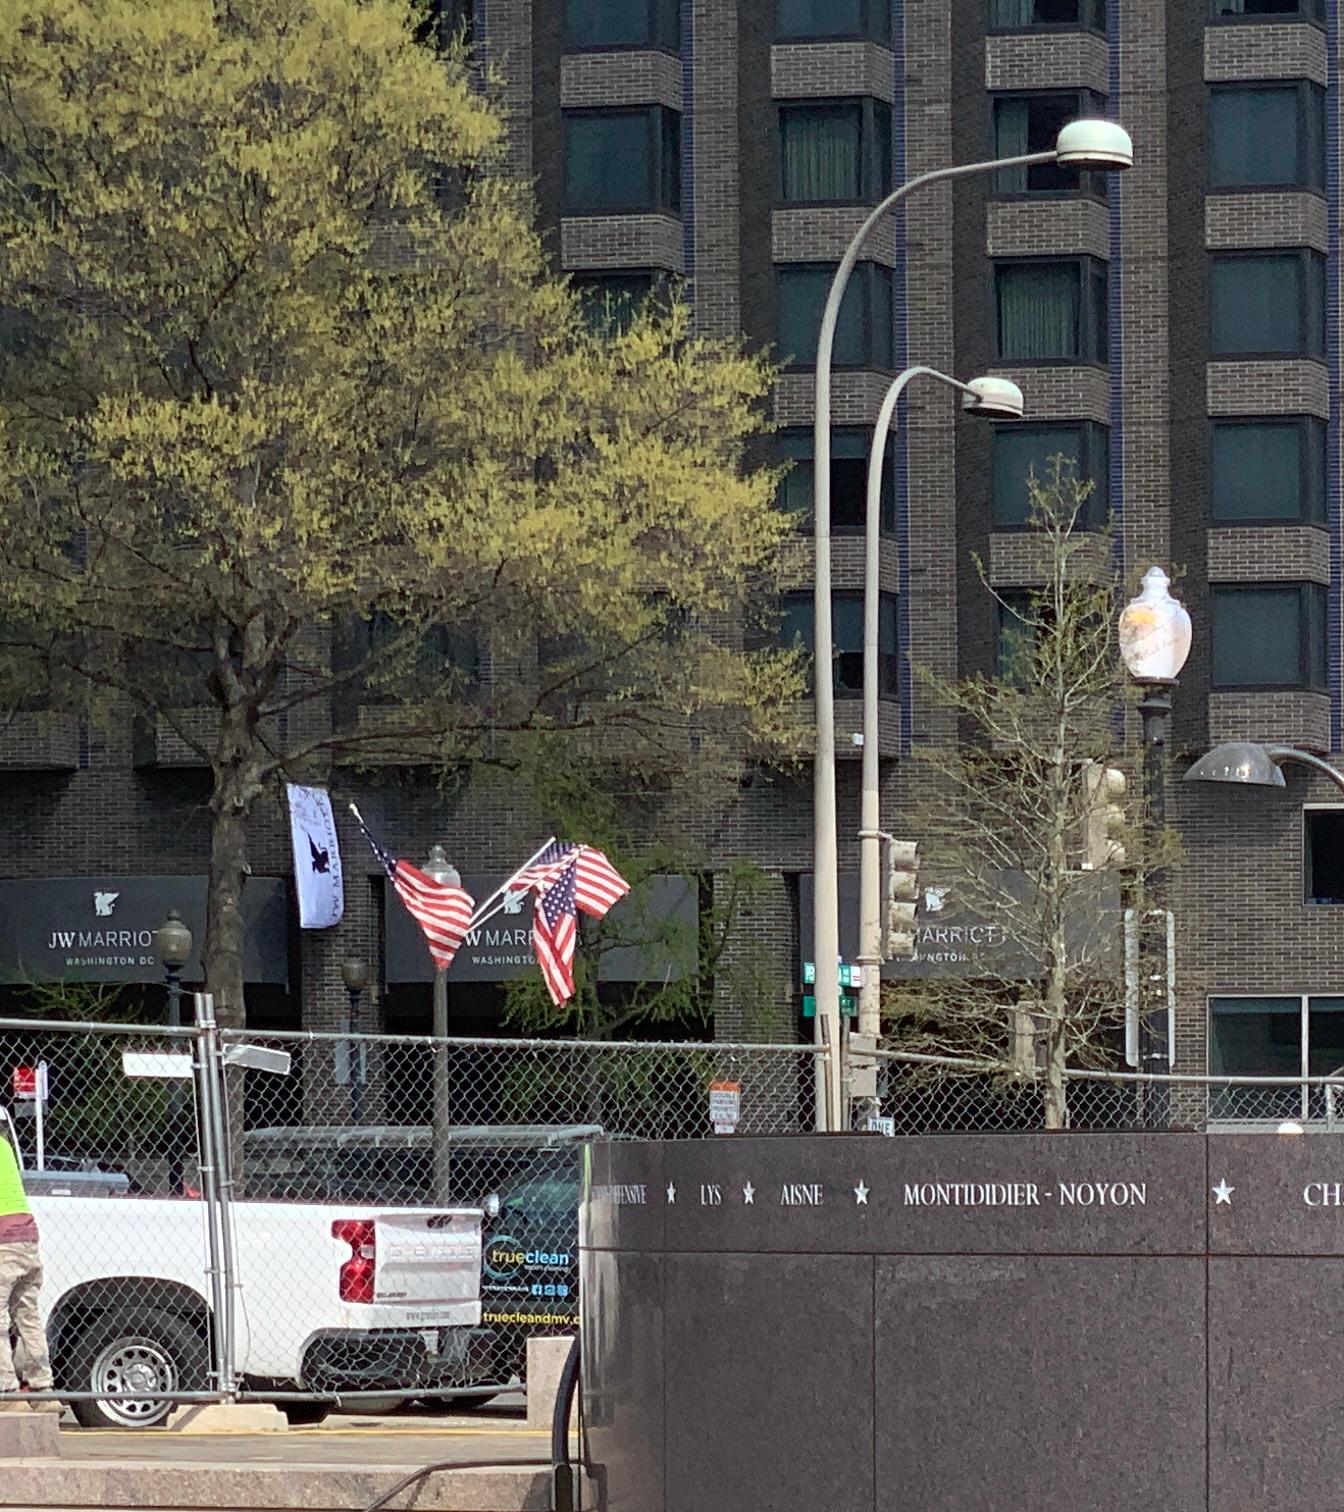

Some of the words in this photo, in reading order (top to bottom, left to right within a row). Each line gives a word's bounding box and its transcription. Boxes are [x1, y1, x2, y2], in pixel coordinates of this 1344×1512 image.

[48, 931, 77, 949] JW
[78, 930, 157, 948] MARRIO
[466, 930, 482, 947] W
[65, 956, 136, 967] WASHINGTON
[139, 956, 155, 966] DC
[471, 955, 541, 966] WASHINGTO
[701, 1184, 722, 1206] LYS
[780, 1183, 825, 1206] AISNE
[904, 1183, 1040, 1206] MONTIDIDIER
[1059, 1183, 1146, 1206] NOYON
[492, 1249, 570, 1265] trueclean
[483, 1312, 581, 1325] truecleandmv.c
